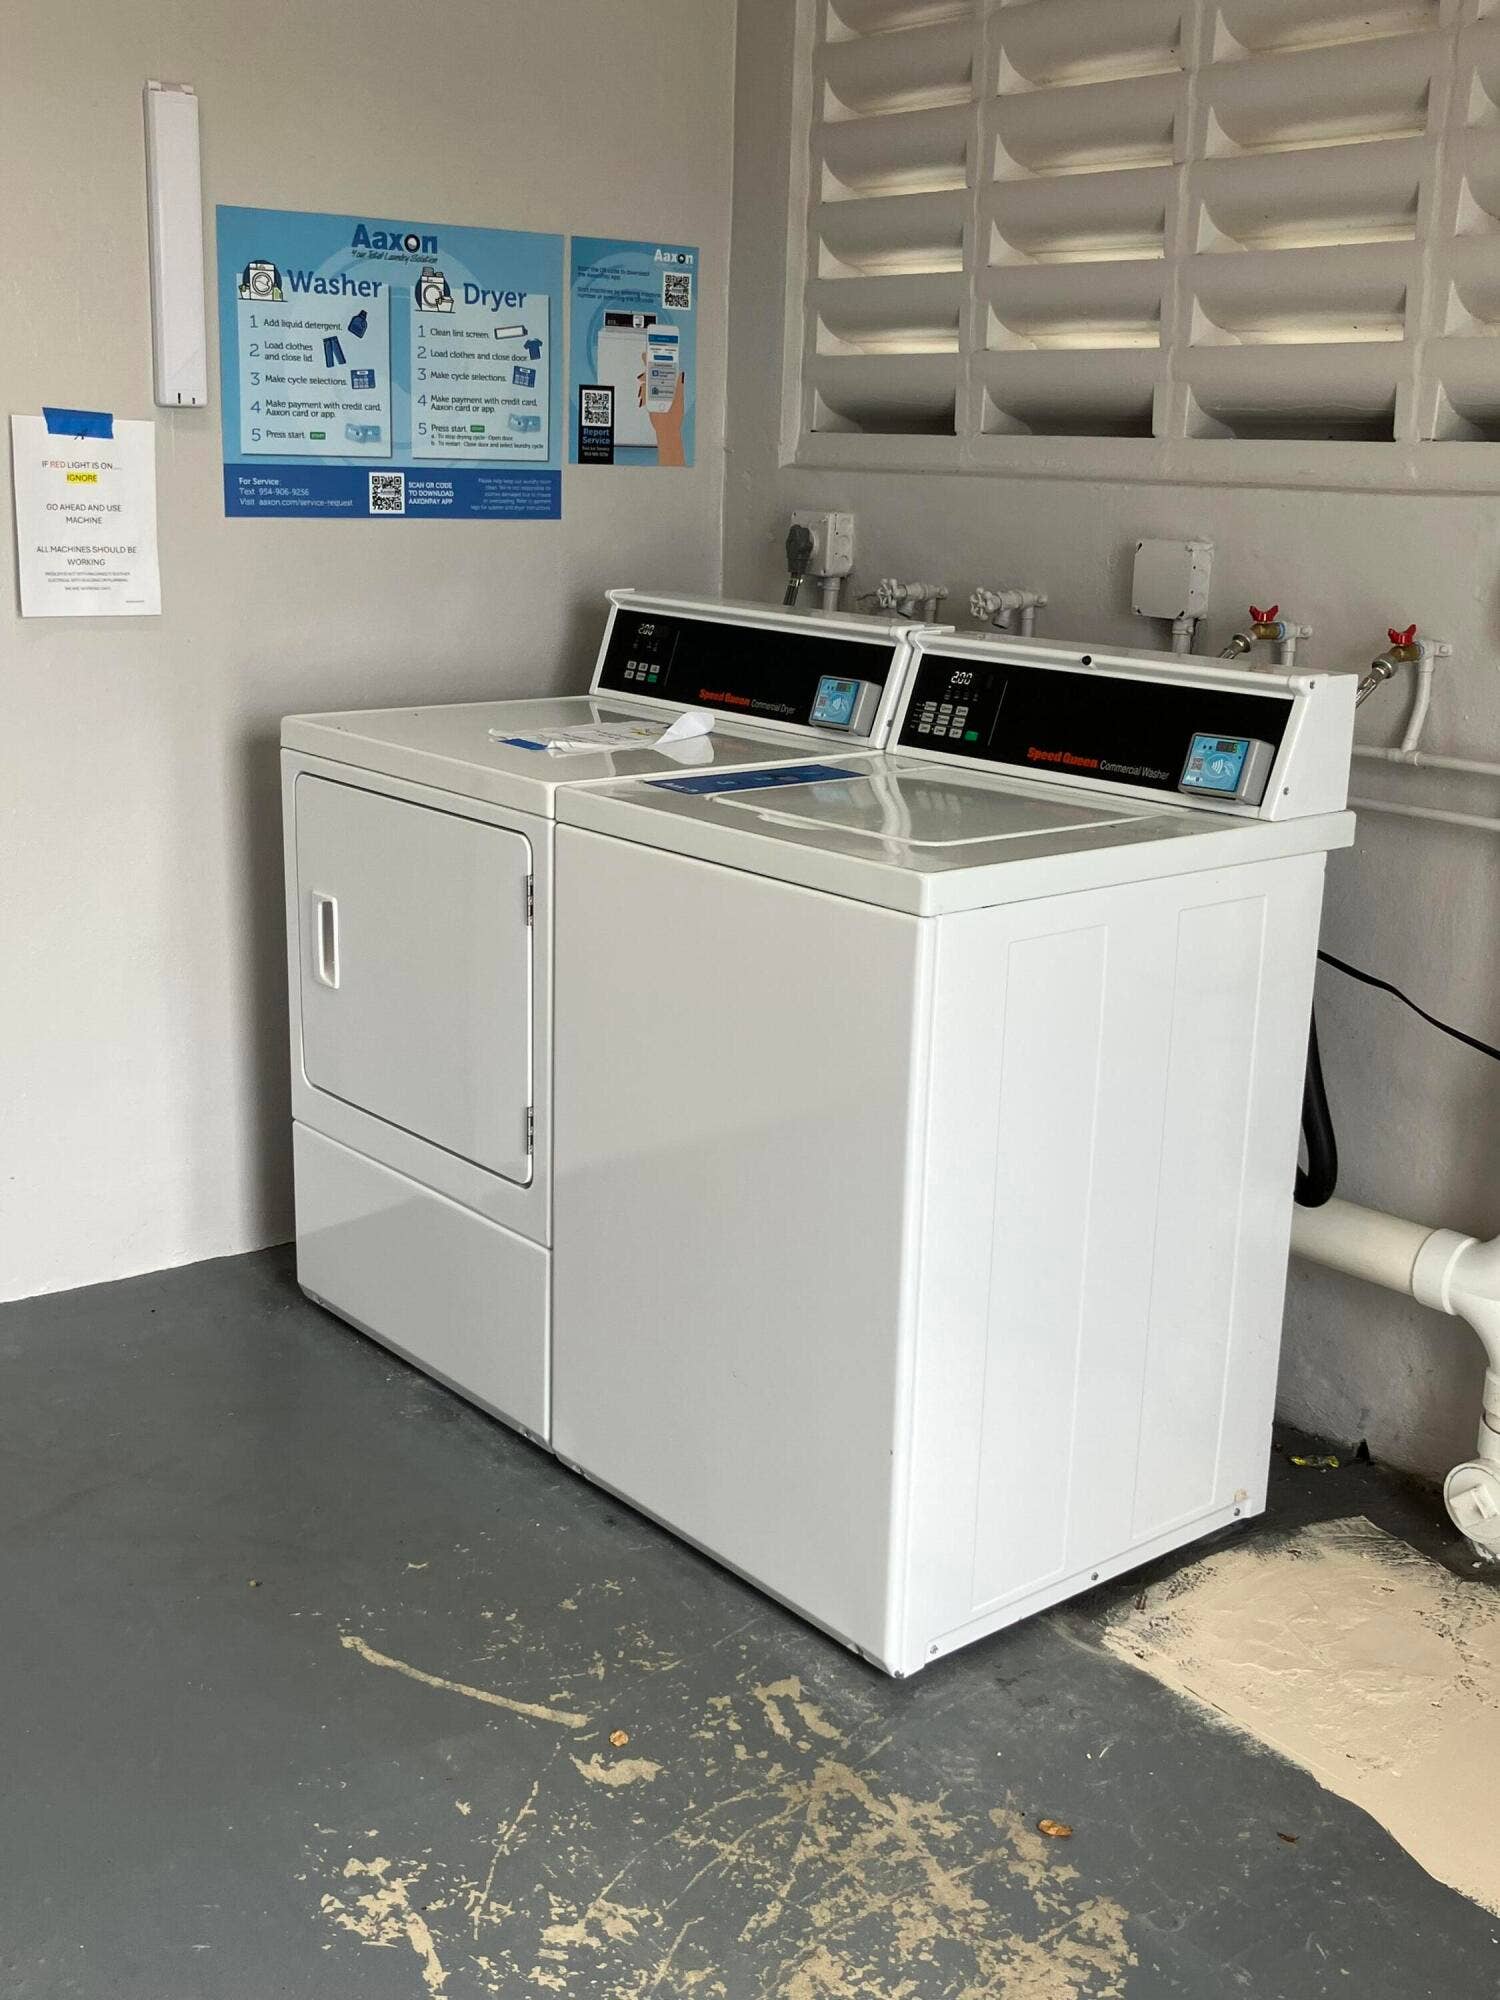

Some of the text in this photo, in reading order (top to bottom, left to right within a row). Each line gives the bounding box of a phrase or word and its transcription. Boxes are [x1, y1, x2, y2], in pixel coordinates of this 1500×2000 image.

[352, 223, 438, 254] Aaxon
[654, 248, 694, 264] Aaxon
[287, 270, 382, 298] Washer
[463, 282, 527, 312] Dryer
[250, 314, 258, 328] 1
[264, 319, 280, 327] Add
[282, 319, 303, 330] liquid
[418, 325, 426, 338] 1
[430, 329, 450, 337] Clean
[250, 341, 313, 357] 2 Load clothes
[418, 346, 427, 358] 2
[430, 349, 448, 358] Load
[450, 350, 475, 360] clothes
[477, 352, 490, 360] and
[492, 352, 510, 360] close
[264, 352, 280, 360] and
[281, 353, 300, 361] close
[250, 372, 260, 386] 3
[266, 374, 285, 382] Make
[287, 376, 308, 386] cycle
[418, 368, 426, 380] 3
[430, 370, 450, 378] Make
[451, 371, 470, 382] cycle
[250, 401, 260, 413] 4
[266, 400, 286, 408] Make
[288, 401, 322, 410] payment
[324, 402, 340, 410] with
[342, 402, 362, 410] credit
[418, 394, 427, 406] 4
[431, 394, 450, 402] Make
[452, 396, 482, 404] payment
[501, 398, 520, 406] credit
[266, 408, 290, 417] Aaxon
[292, 410, 308, 418] card
[455, 404, 470, 412] card
[252, 428, 261, 442] 5
[418, 422, 427, 435] 5
[431, 424, 450, 432] Press
[583, 428, 609, 436] Report
[582, 436, 610, 444] Service
[42, 460, 48, 468] IF
[66, 474, 97, 482] IGNORE
[238, 477, 250, 486] For
[88, 504, 106, 512] AND
[107, 504, 122, 512] USE
[66, 516, 102, 524] MACHINE
[50, 546, 90, 554] MACHINES
[92, 546, 126, 554] SHOULD
[128, 546, 136, 554] BE
[67, 558, 106, 566] WORKING
[699, 689, 796, 715] Speed Queen Commercial Dryer
[1027, 747, 1170, 780] Speed Queen Commercial Washer
